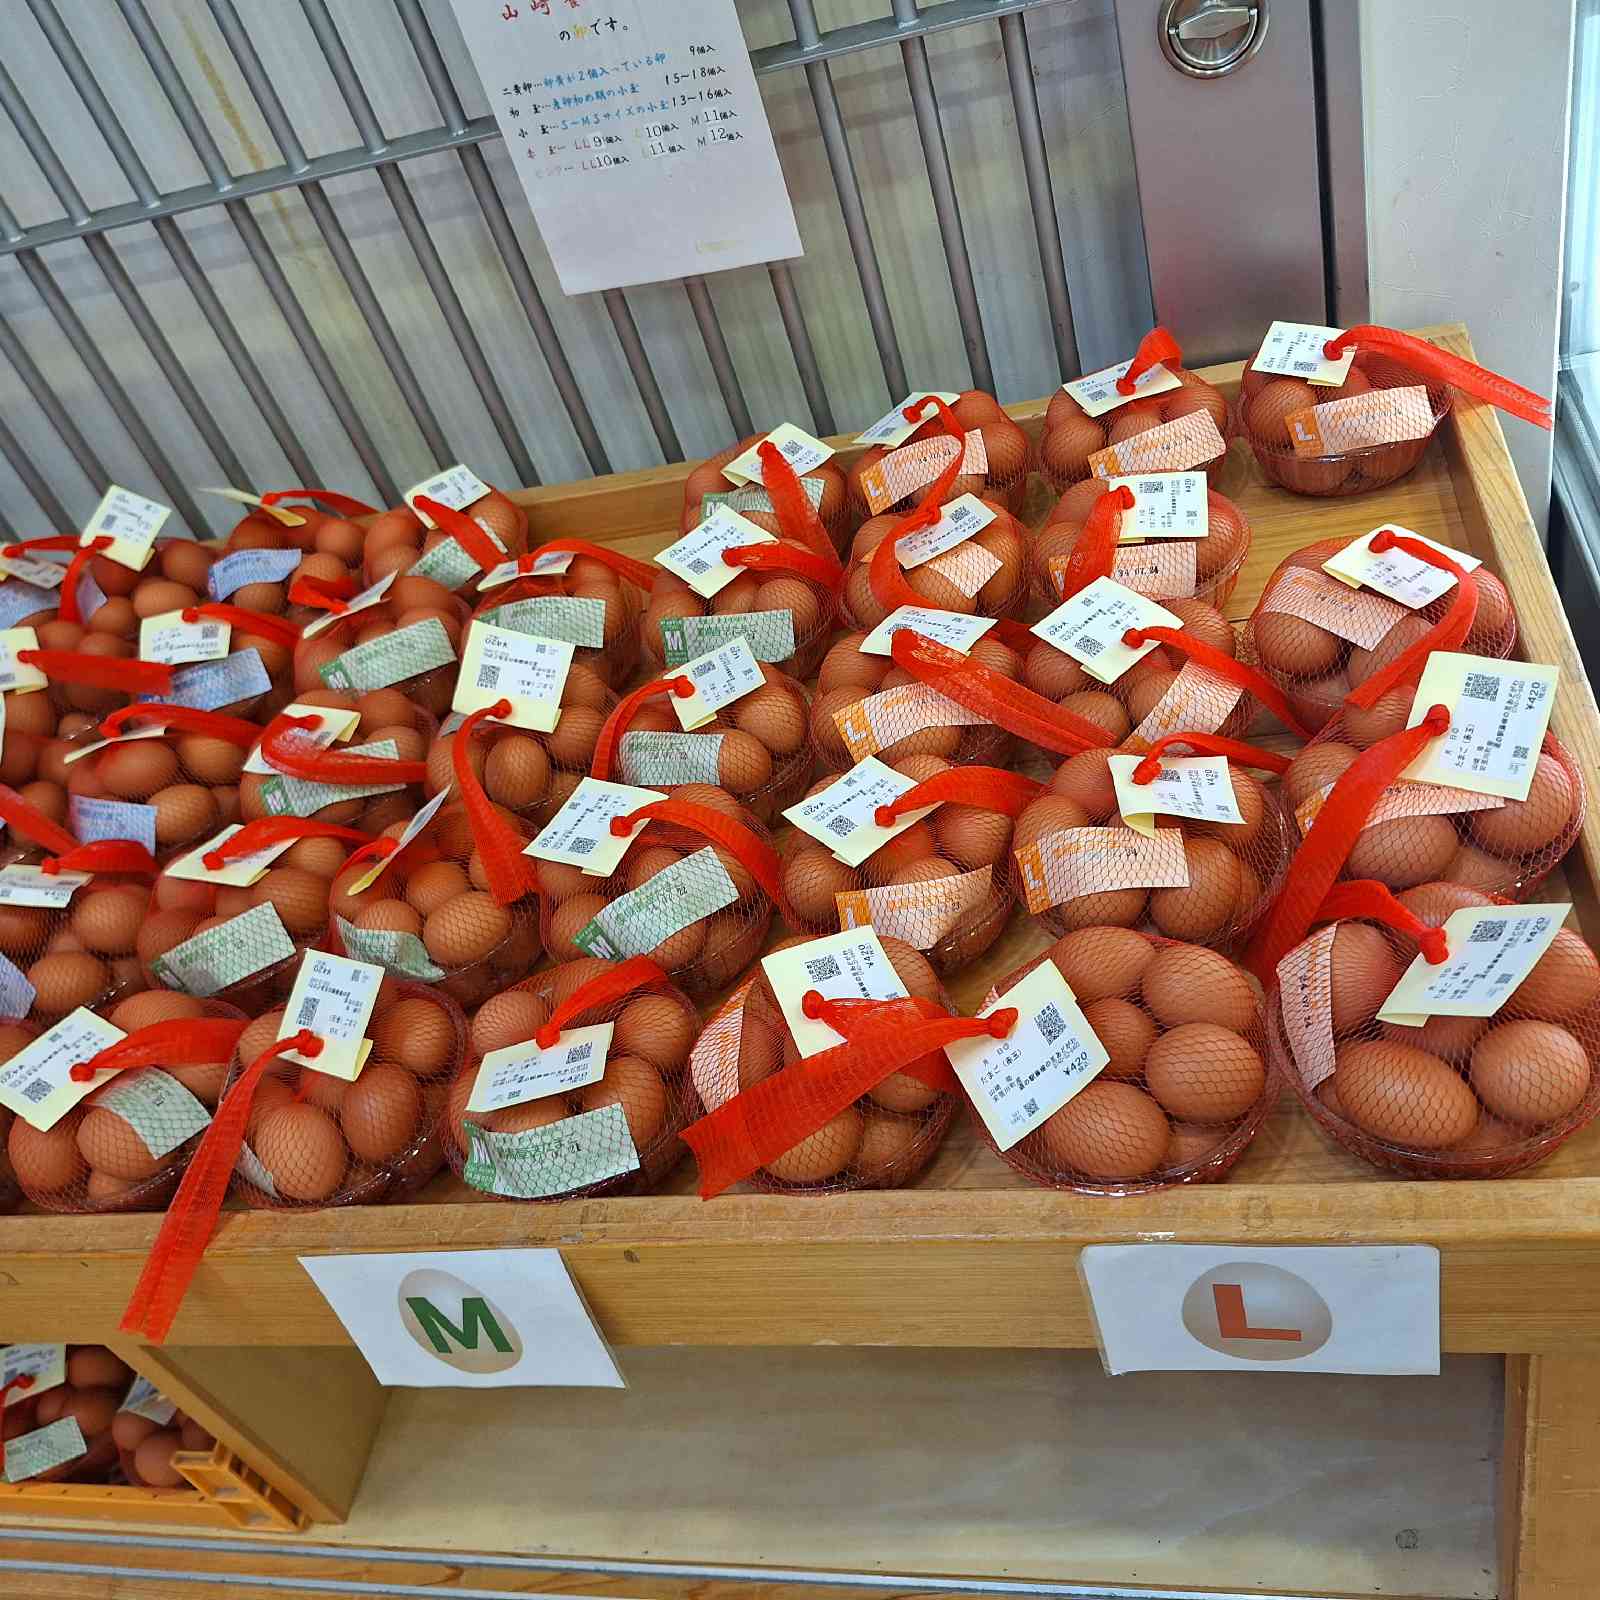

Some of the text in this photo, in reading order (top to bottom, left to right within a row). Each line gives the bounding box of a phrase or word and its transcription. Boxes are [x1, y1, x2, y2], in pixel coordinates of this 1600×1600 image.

[1294, 423, 1316, 443] L
[1525, 681, 1542, 711] ¥420
[845, 720, 866, 742] L
[1024, 863, 1042, 889] L
[1063, 1052, 1088, 1076] ¥420
[405, 1297, 514, 1353] M
[1212, 1284, 1301, 1341] L
